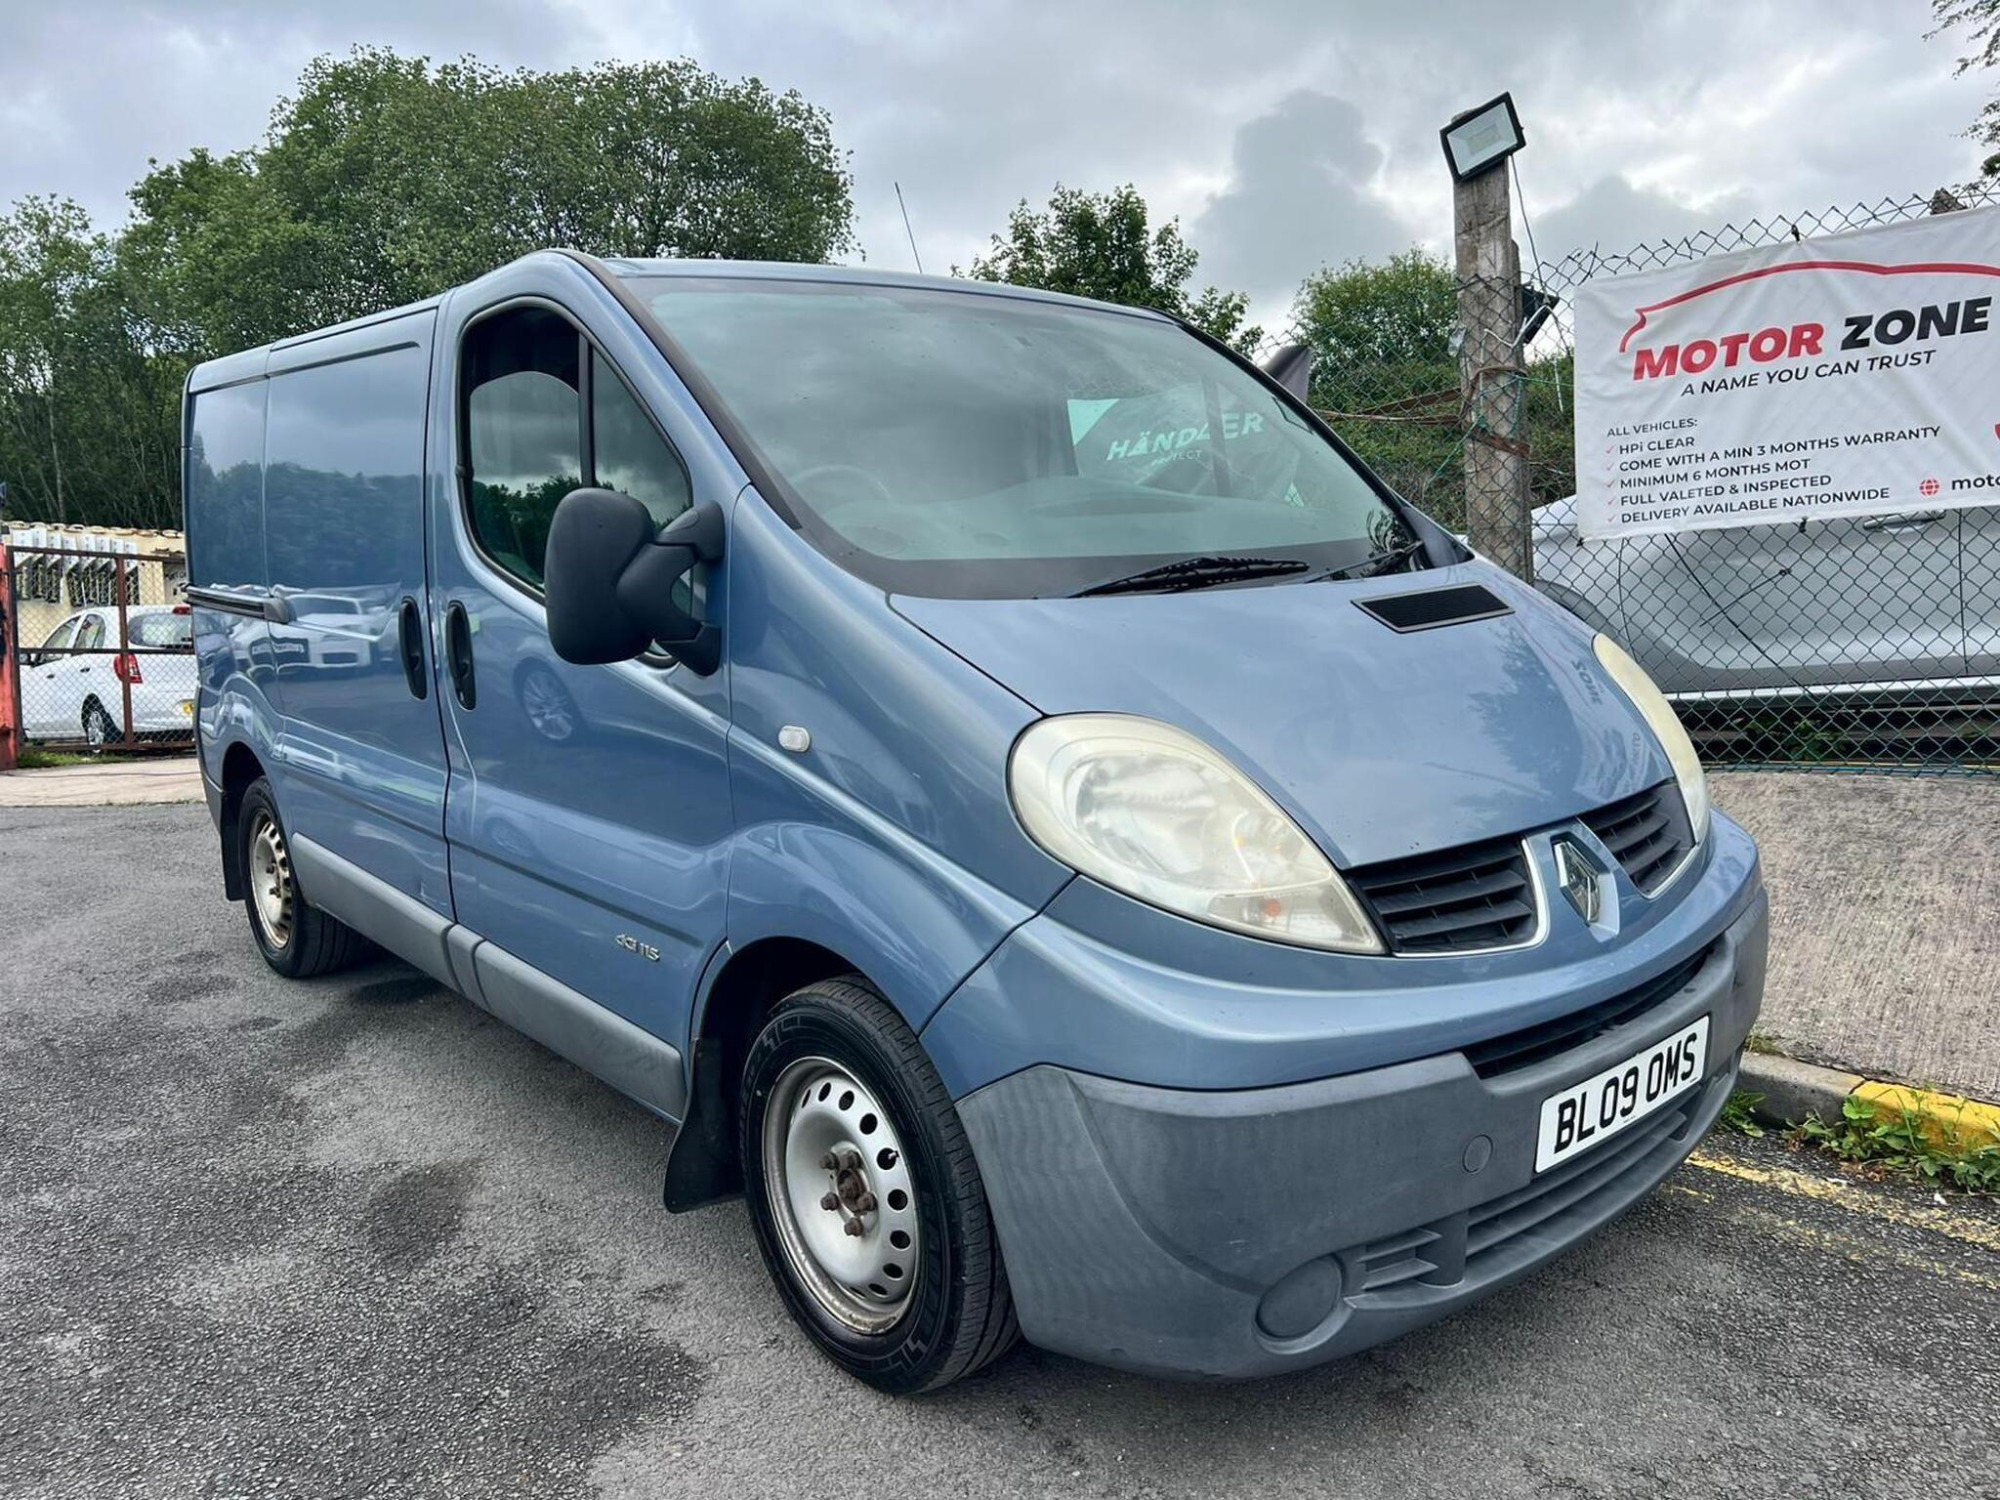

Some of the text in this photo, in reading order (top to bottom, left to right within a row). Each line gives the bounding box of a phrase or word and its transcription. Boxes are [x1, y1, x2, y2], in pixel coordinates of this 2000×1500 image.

[1633, 296, 1993, 381] MOTOR ZONE
[1681, 350, 1936, 397] A NAME YOU CAN TRUST
[1606, 418, 1698, 437] ALL VEHICLES:
[1619, 436, 1695, 455] HPi CLEAR
[1619, 426, 1941, 472] COME WITH A MIN 3 MONTHS WARRANTY
[1620, 458, 1811, 489] MINIMUM 6 MONTHS MOT
[1620, 475, 1832, 506] FULL VALETED & INSPECTED
[1621, 487, 1890, 523] DELIVERY AVAILABLE NATIONWIDE
[1554, 1032, 1698, 1154] BL09 OMS
